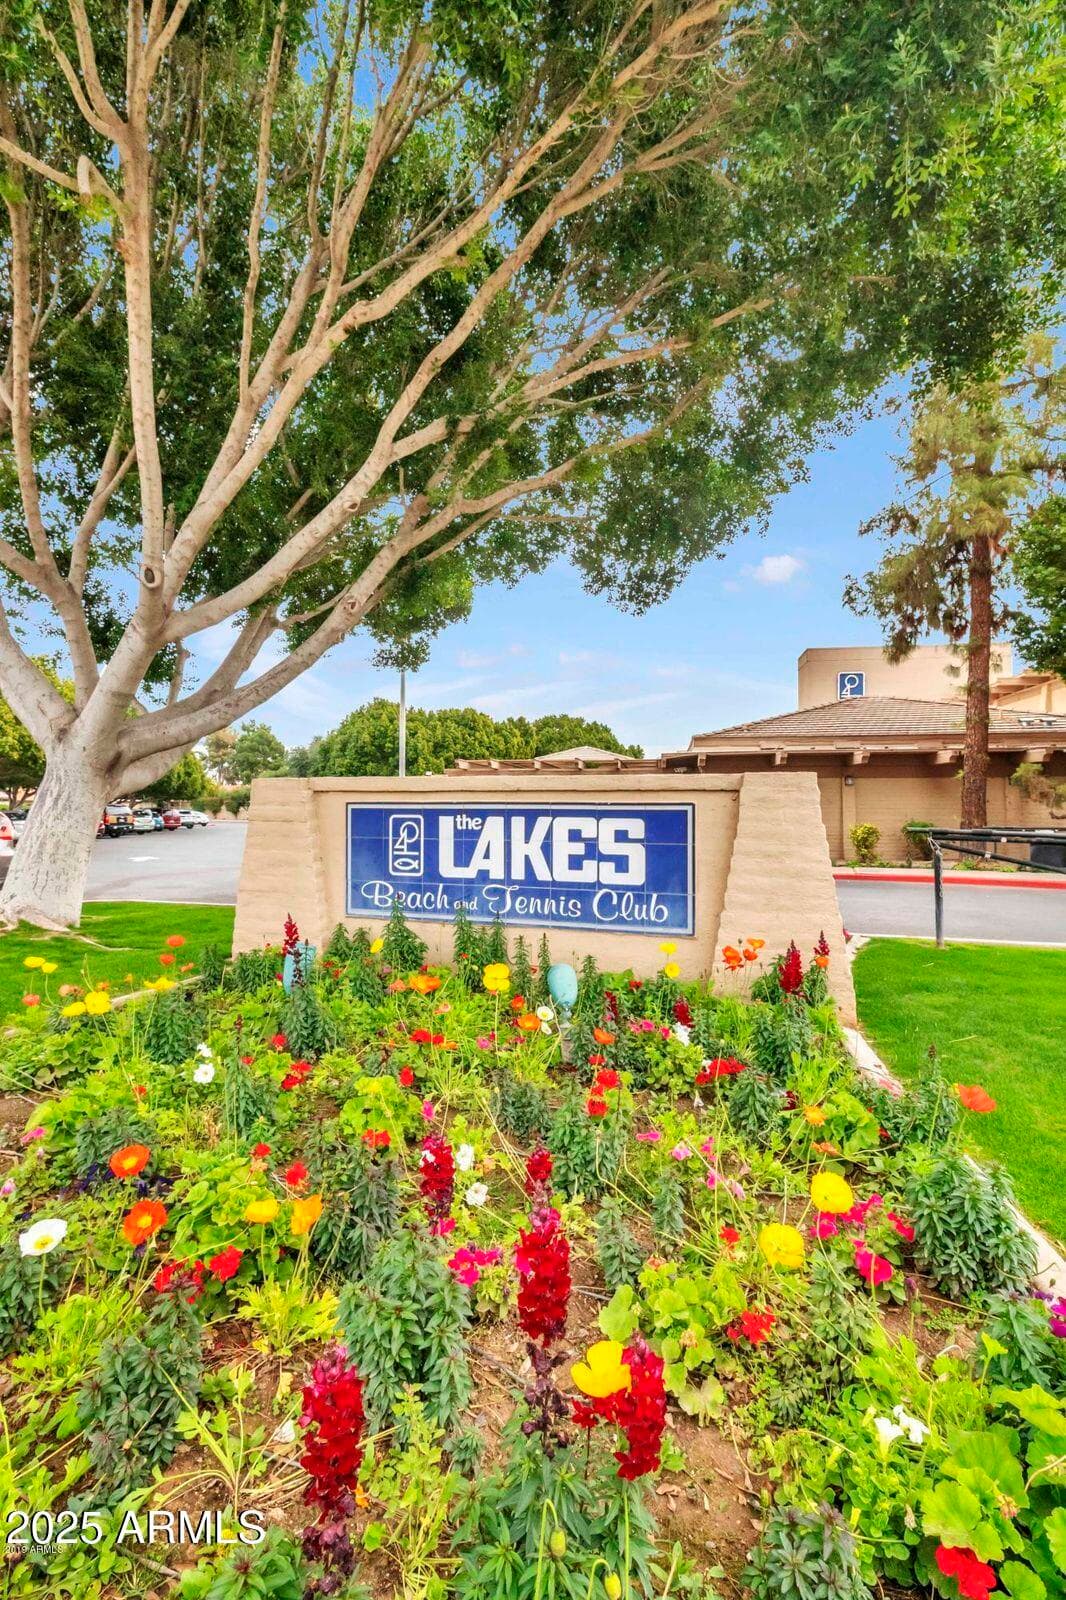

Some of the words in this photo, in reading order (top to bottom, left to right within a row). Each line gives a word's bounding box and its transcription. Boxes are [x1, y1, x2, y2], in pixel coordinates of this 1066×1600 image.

[456, 814, 482, 831] the
[439, 815, 646, 886] LAKES
[361, 880, 449, 909] Beach
[482, 884, 582, 917] Tennis
[592, 888, 669, 923] Club
